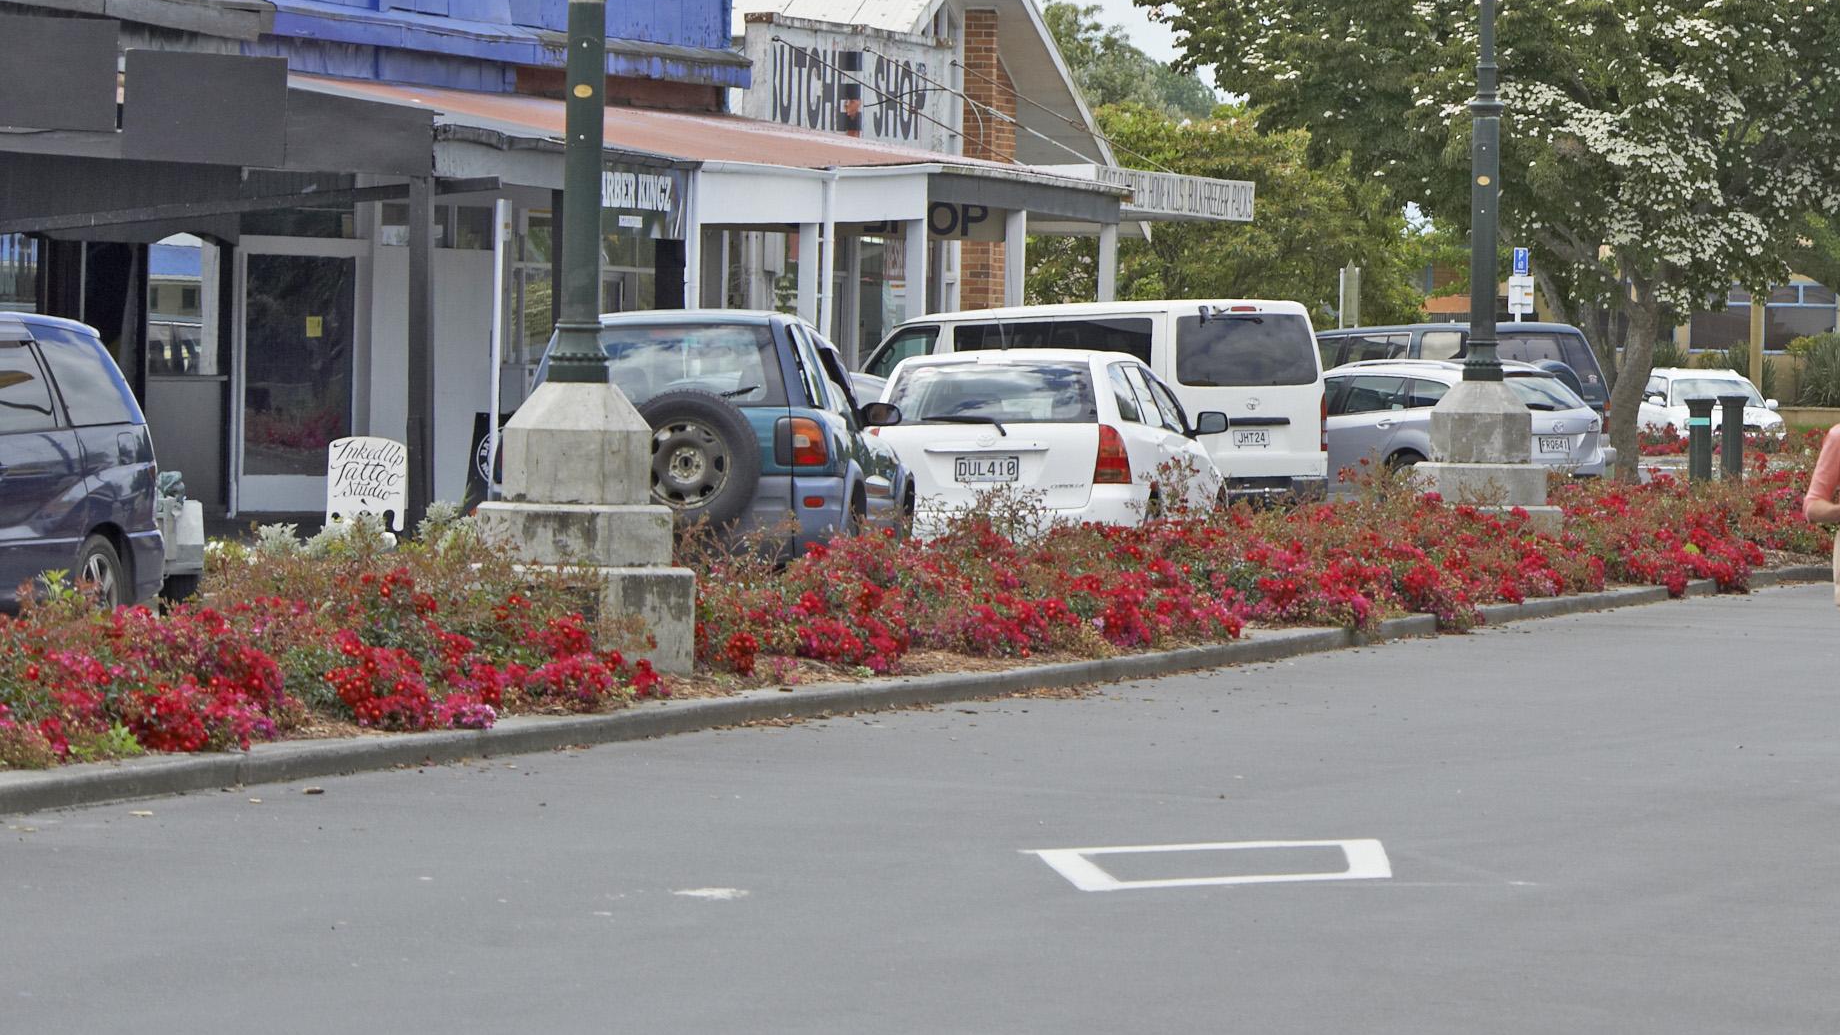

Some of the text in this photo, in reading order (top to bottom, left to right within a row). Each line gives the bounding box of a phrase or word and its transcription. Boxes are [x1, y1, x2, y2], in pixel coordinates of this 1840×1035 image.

[873, 55, 927, 141] SHOP
[602, 171, 672, 212] ARBER KINGZ
[1231, 184, 1253, 218] PACKS
[1238, 432, 1266, 444] JHT24
[331, 460, 405, 487] Tattoo
[958, 461, 1016, 476] DUL410
